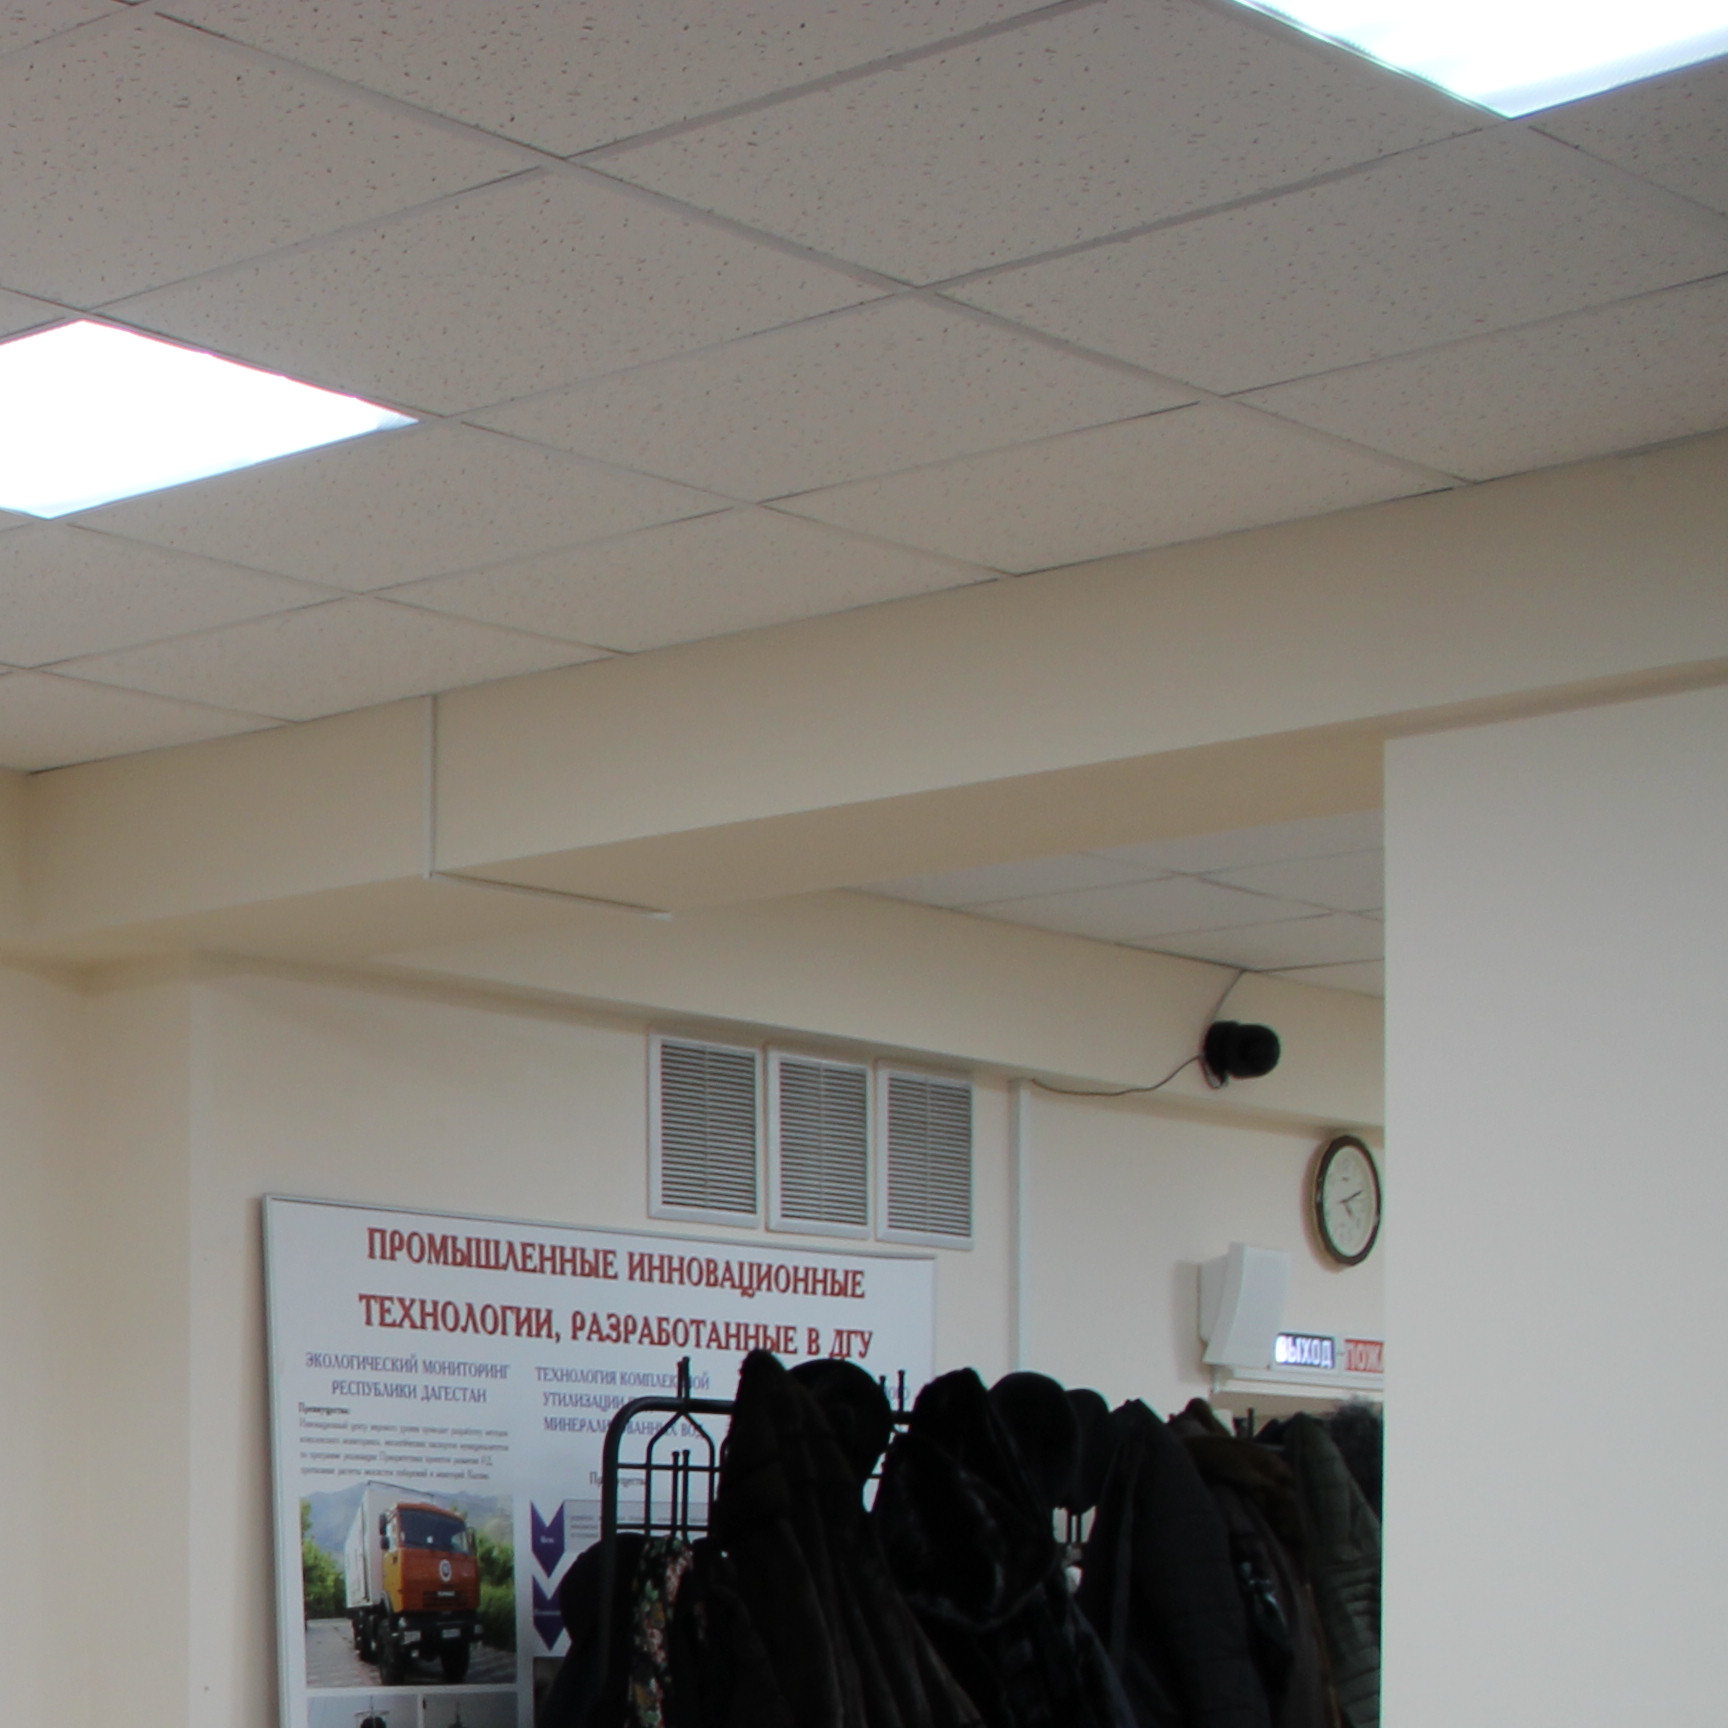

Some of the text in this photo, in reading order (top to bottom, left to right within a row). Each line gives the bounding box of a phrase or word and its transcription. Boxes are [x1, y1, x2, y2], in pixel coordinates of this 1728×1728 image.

[367, 1227, 865, 1298] ПРОМЫШЛЕННЫЕ ИННОВАЦИОННЫЕ
[358, 1294, 873, 1359] ТЕХНОЛОГИИ, РАЗРАБОТАННЫЕ В ДГУ
[305, 1352, 510, 1379] ЭКОЛОГИЧЕСКИЙ МОНИТОРИНГ
[535, 1366, 617, 1385] ТЕХНОЛОГИЯ
[332, 1380, 487, 1403] РЕСПУБЛИКИ ДАГЕСТАН
